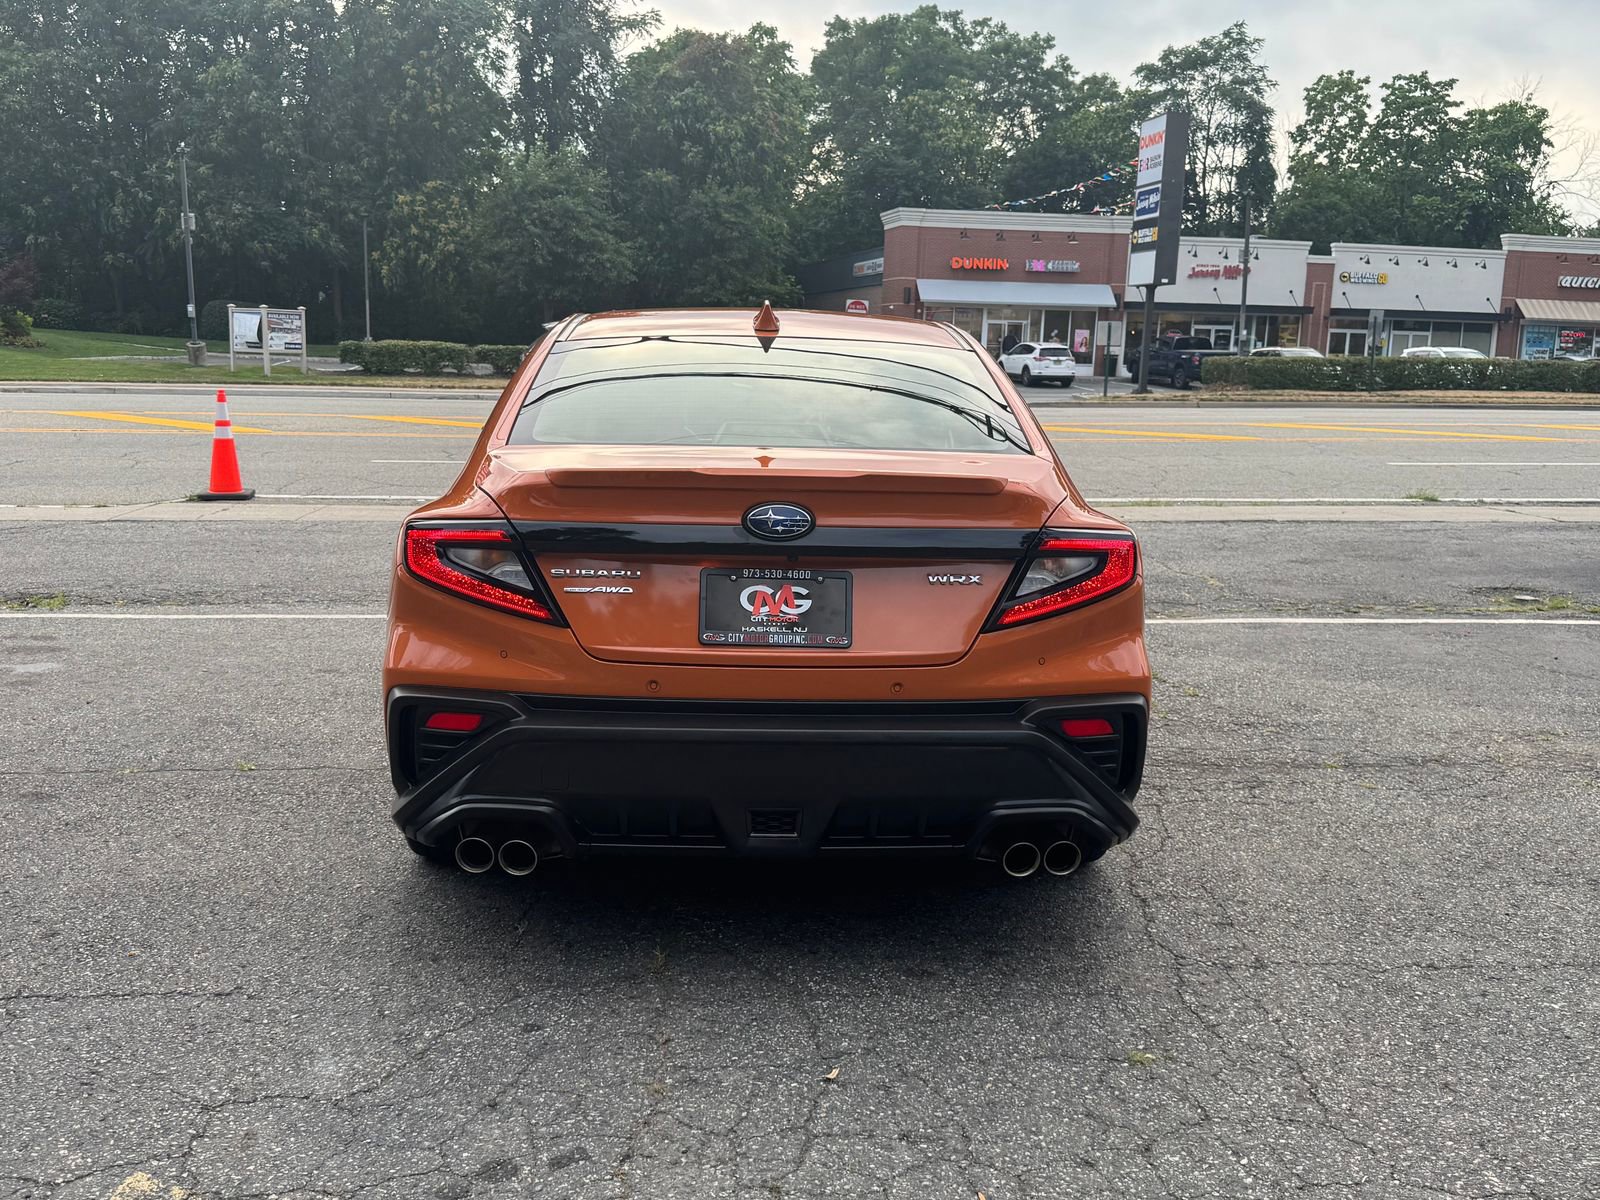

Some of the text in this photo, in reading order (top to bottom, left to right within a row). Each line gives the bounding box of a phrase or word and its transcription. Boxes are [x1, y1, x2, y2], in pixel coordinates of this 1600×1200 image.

[1187, 266, 1220, 280] Jersey
[550, 568, 641, 578] SUBARU
[743, 568, 811, 580] 973-530-4600
[928, 574, 982, 584] WRX
[728, 633, 824, 645] CITYMOTORGROUPINC.COM
